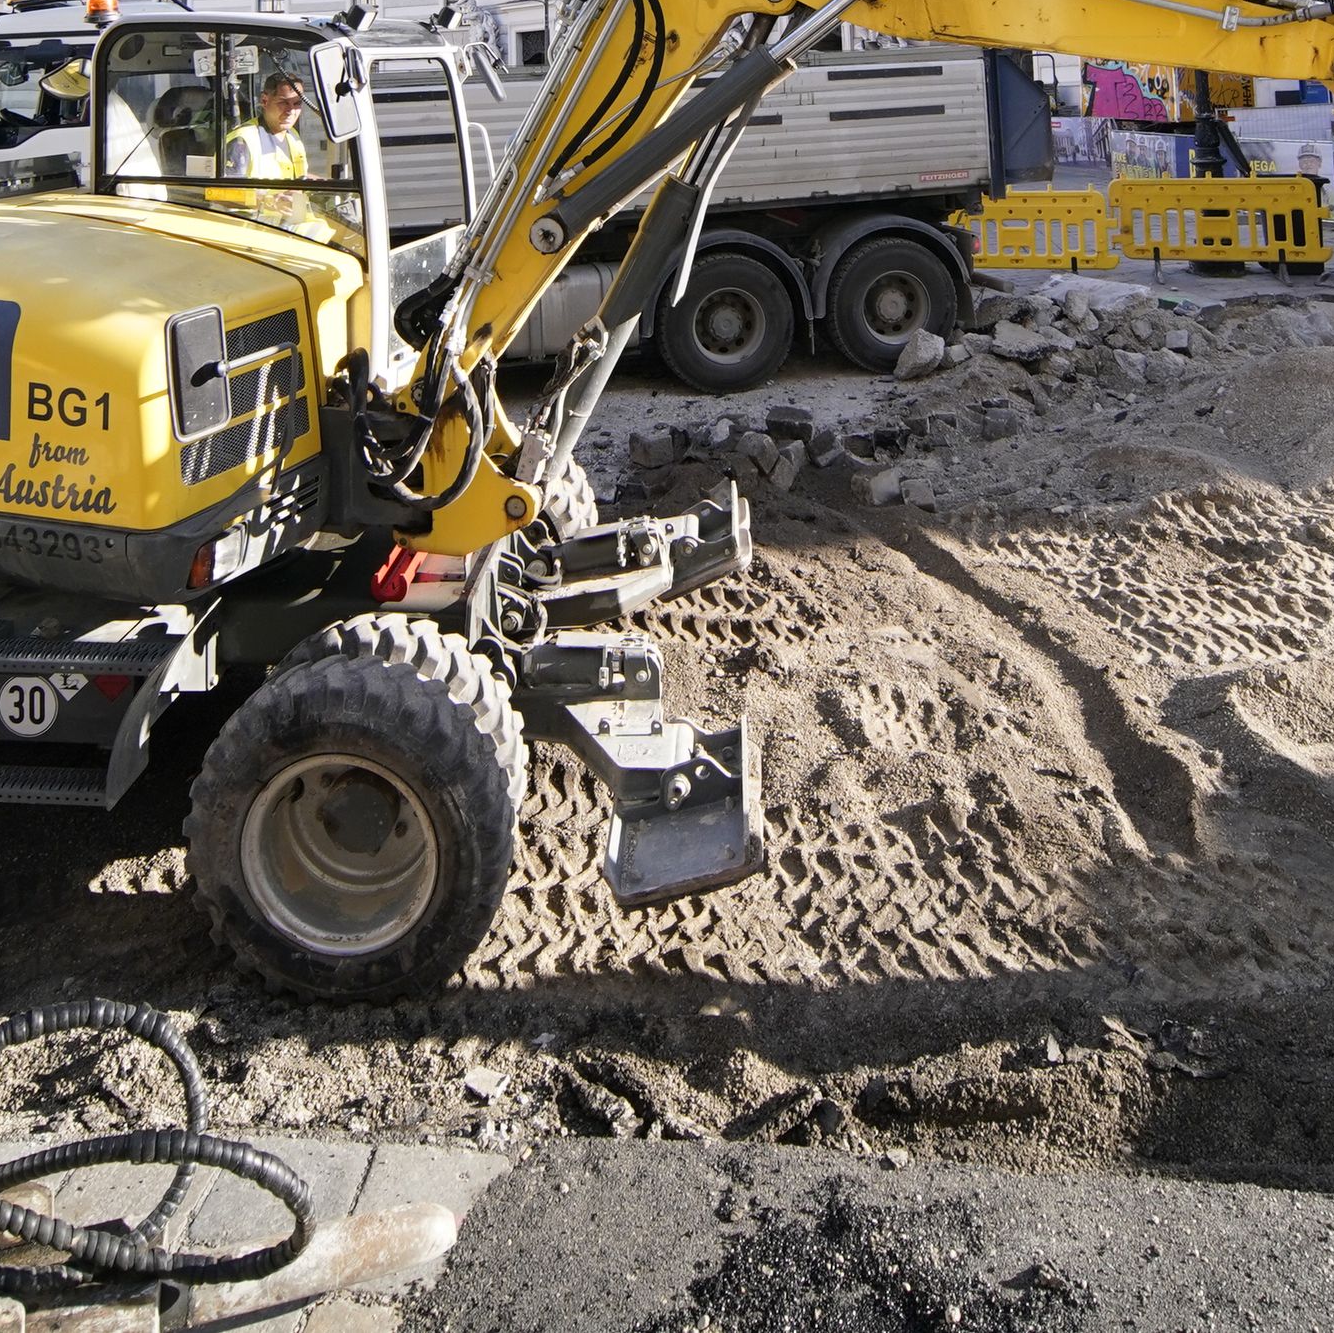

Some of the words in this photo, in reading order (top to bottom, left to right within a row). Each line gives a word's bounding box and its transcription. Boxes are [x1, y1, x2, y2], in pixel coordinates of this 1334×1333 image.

[27, 382, 111, 431] BG1
[28, 432, 90, 468] from
[8, 685, 46, 725] 30
